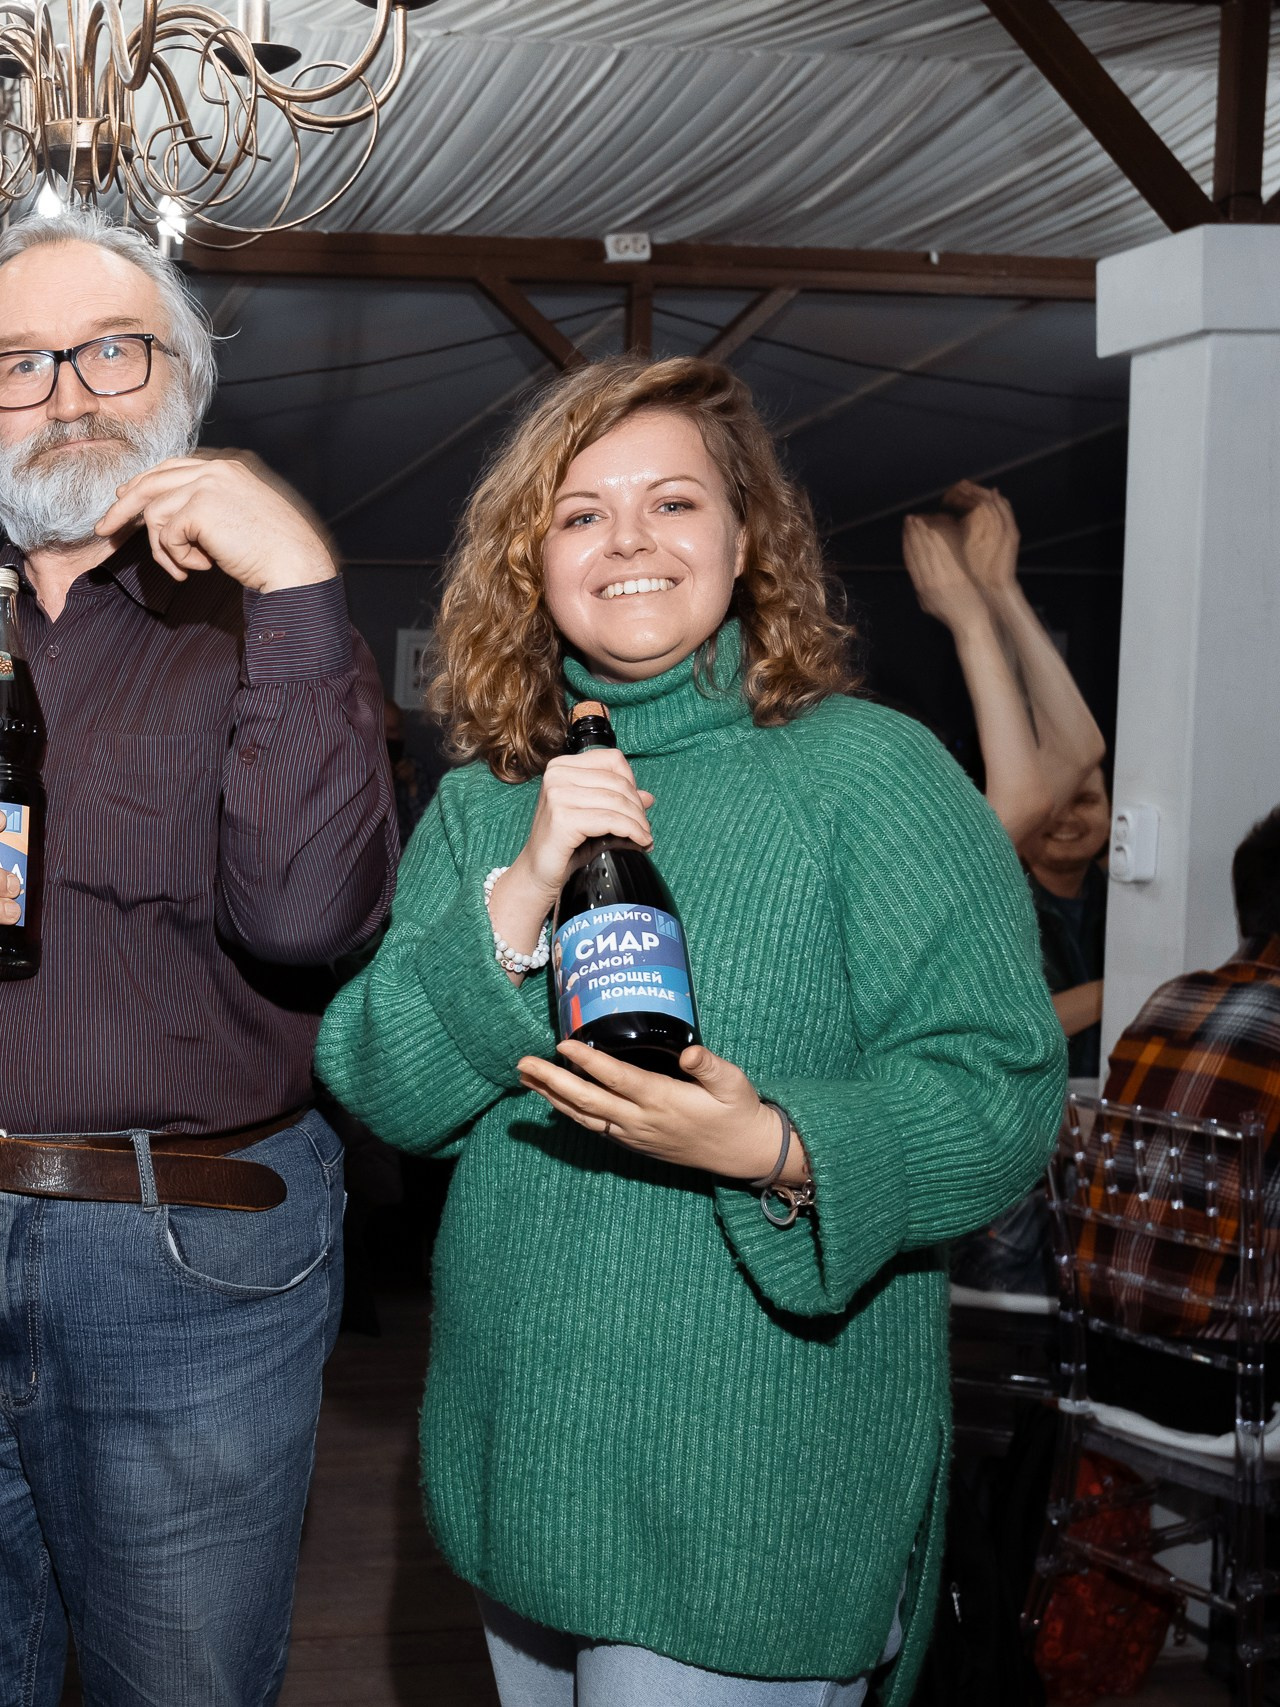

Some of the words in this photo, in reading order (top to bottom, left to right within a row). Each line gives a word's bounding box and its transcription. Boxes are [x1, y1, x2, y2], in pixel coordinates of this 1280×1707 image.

[562, 919, 590, 942] ЛИГА
[593, 911, 652, 925] ИНДИГО
[575, 930, 660, 960] СИДР
[579, 953, 635, 976] САМОЙ
[588, 971, 663, 990] ПОЮЩЕЙ
[601, 985, 676, 1002] КОМАНДЕ
